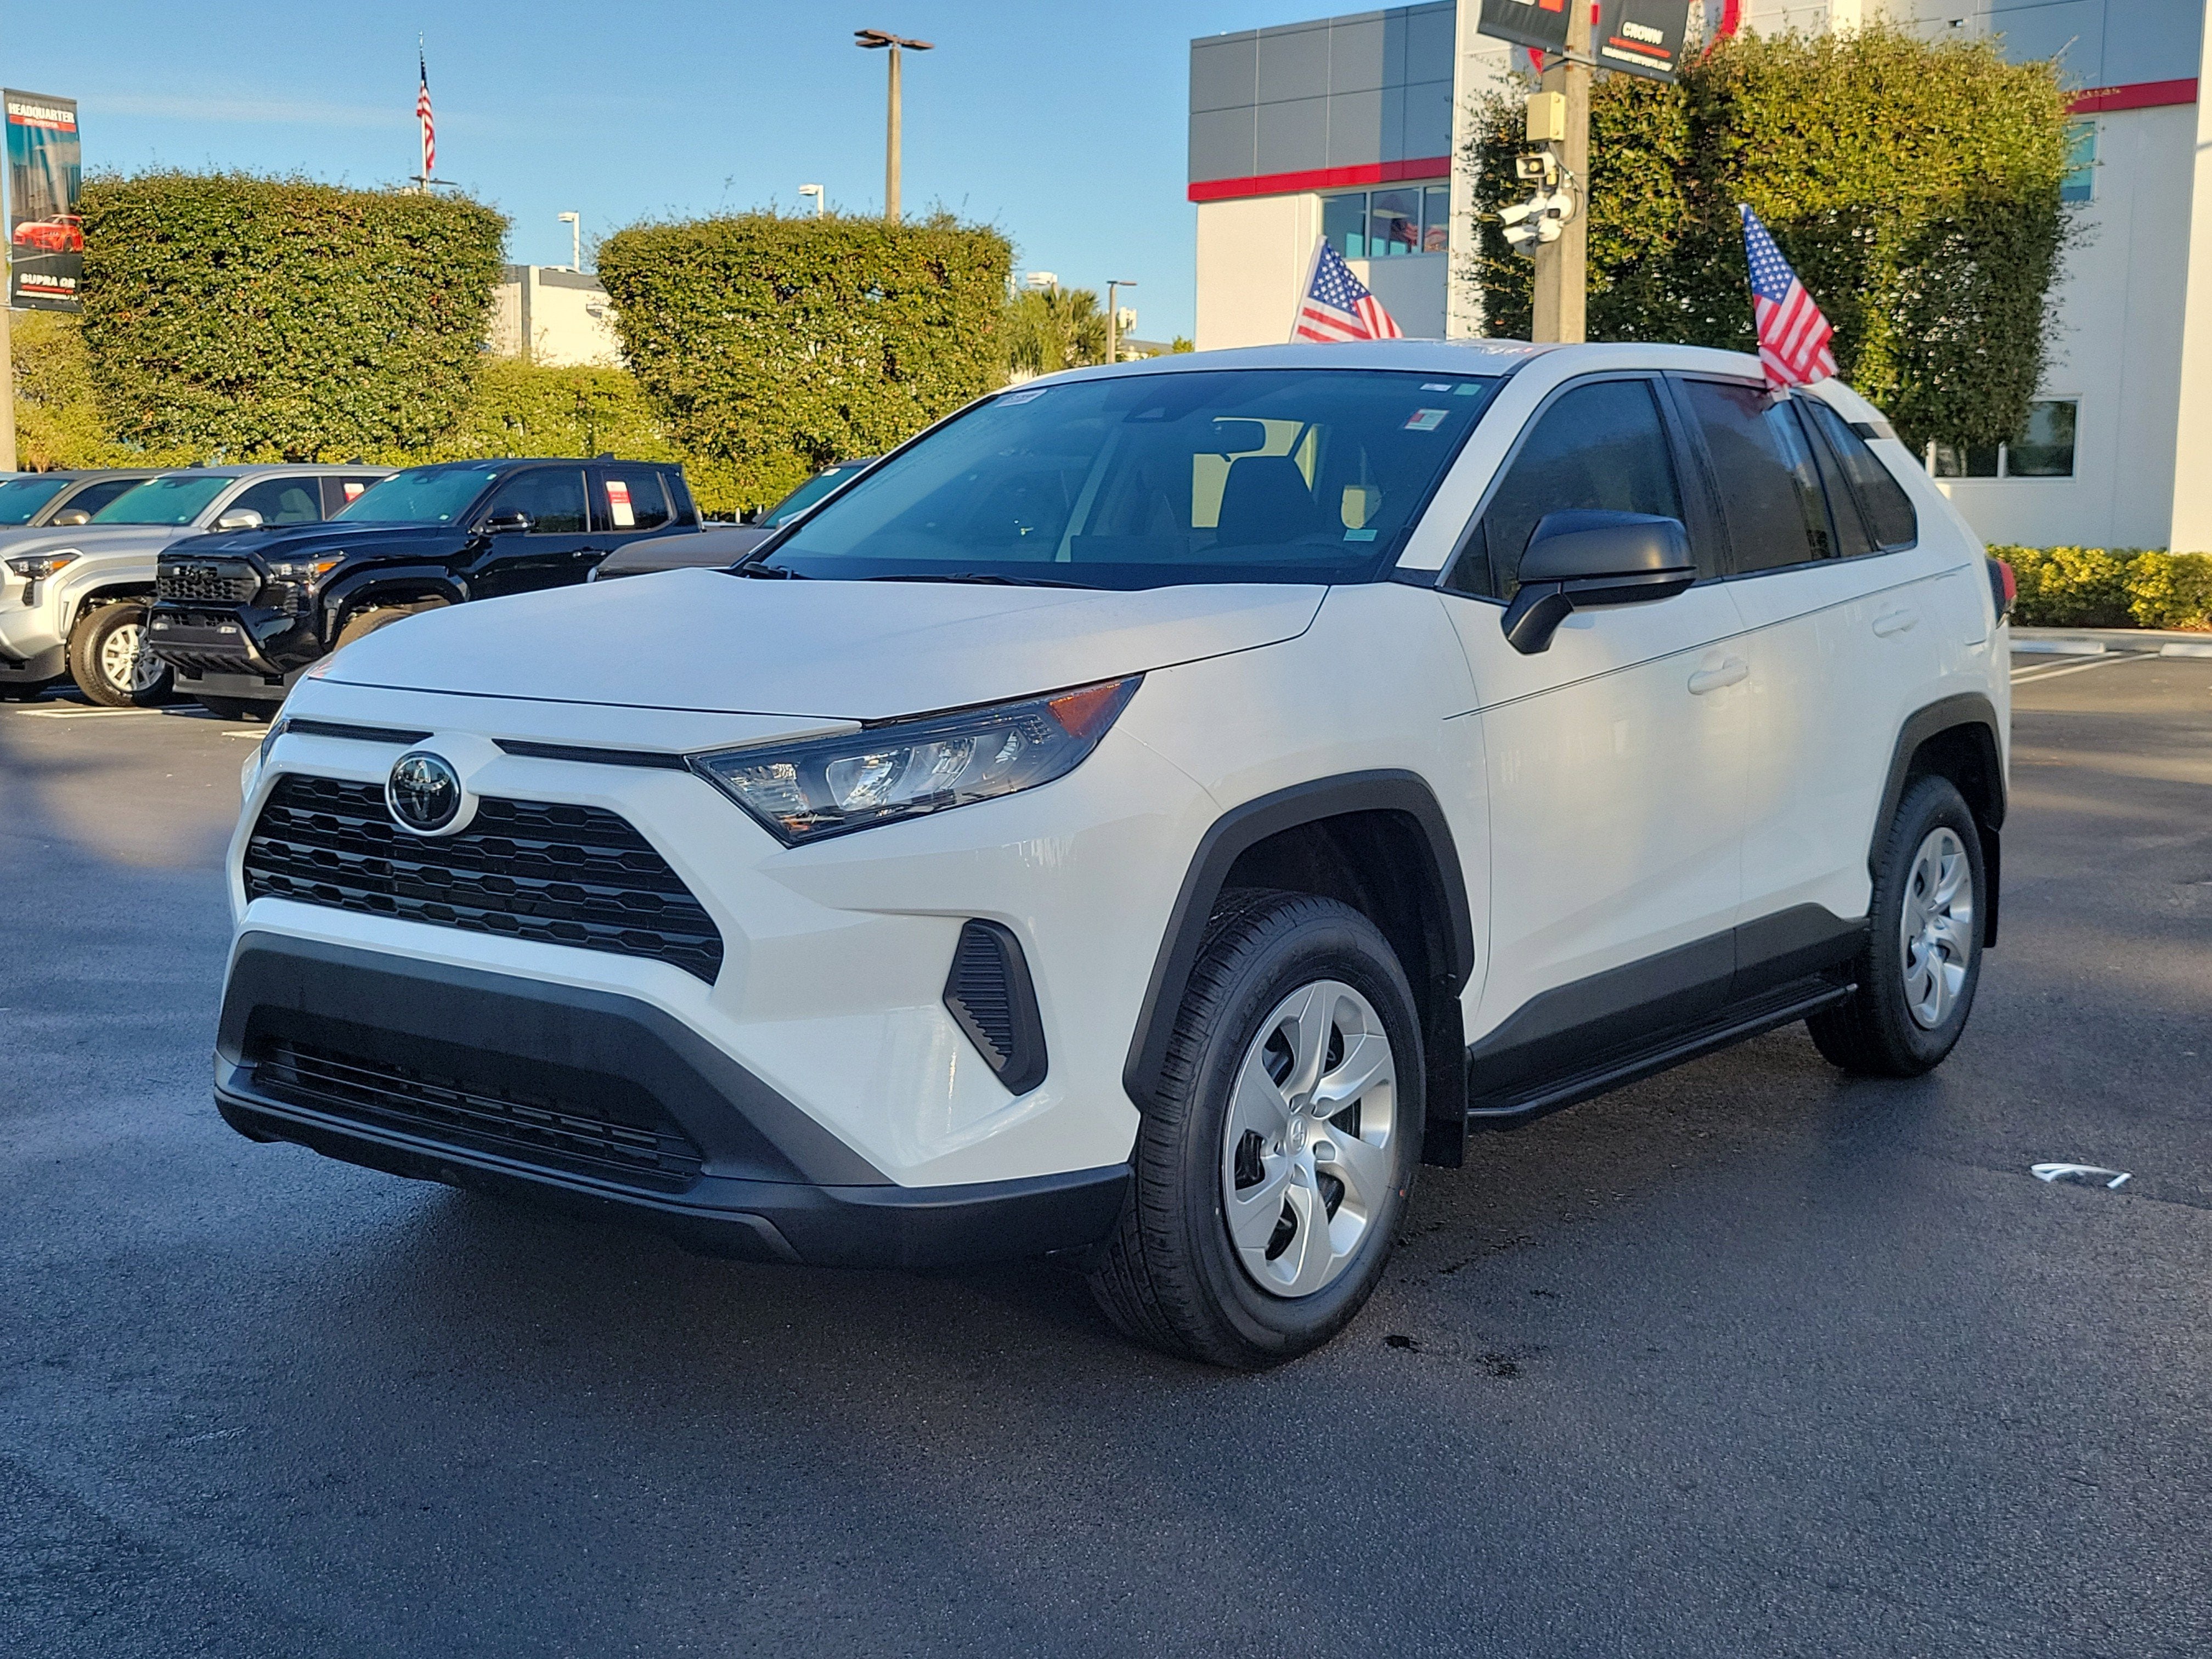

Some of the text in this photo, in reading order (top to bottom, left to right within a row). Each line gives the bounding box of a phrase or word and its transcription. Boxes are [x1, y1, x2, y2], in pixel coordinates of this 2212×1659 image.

[1623, 21, 1663, 44] CROWN
[8, 103, 75, 123] HEADQUARTER
[20, 273, 58, 286] SUPRA
